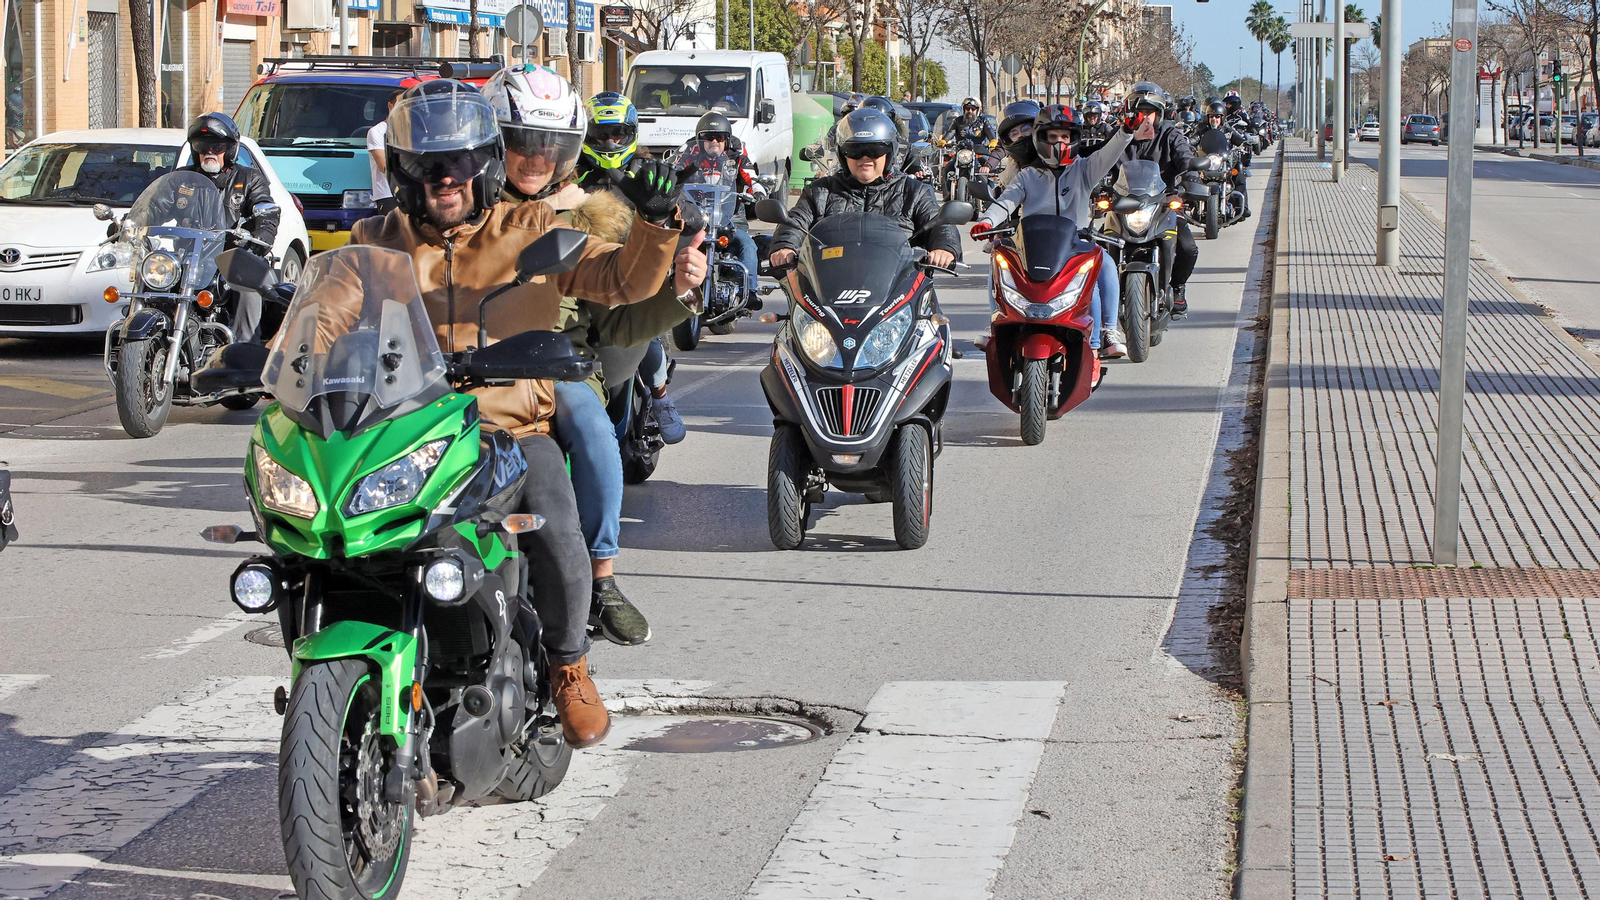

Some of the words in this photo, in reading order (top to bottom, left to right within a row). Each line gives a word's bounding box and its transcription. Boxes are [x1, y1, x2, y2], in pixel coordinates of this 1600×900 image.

[256, 1, 276, 12] Toli
[15, 288, 42, 301] HKJ
[803, 293, 826, 318] Touring
[878, 293, 906, 317] Touring
[322, 376, 365, 386] Kawasaki
[783, 357, 798, 383] METZELER
[900, 358, 918, 385] METZELER
